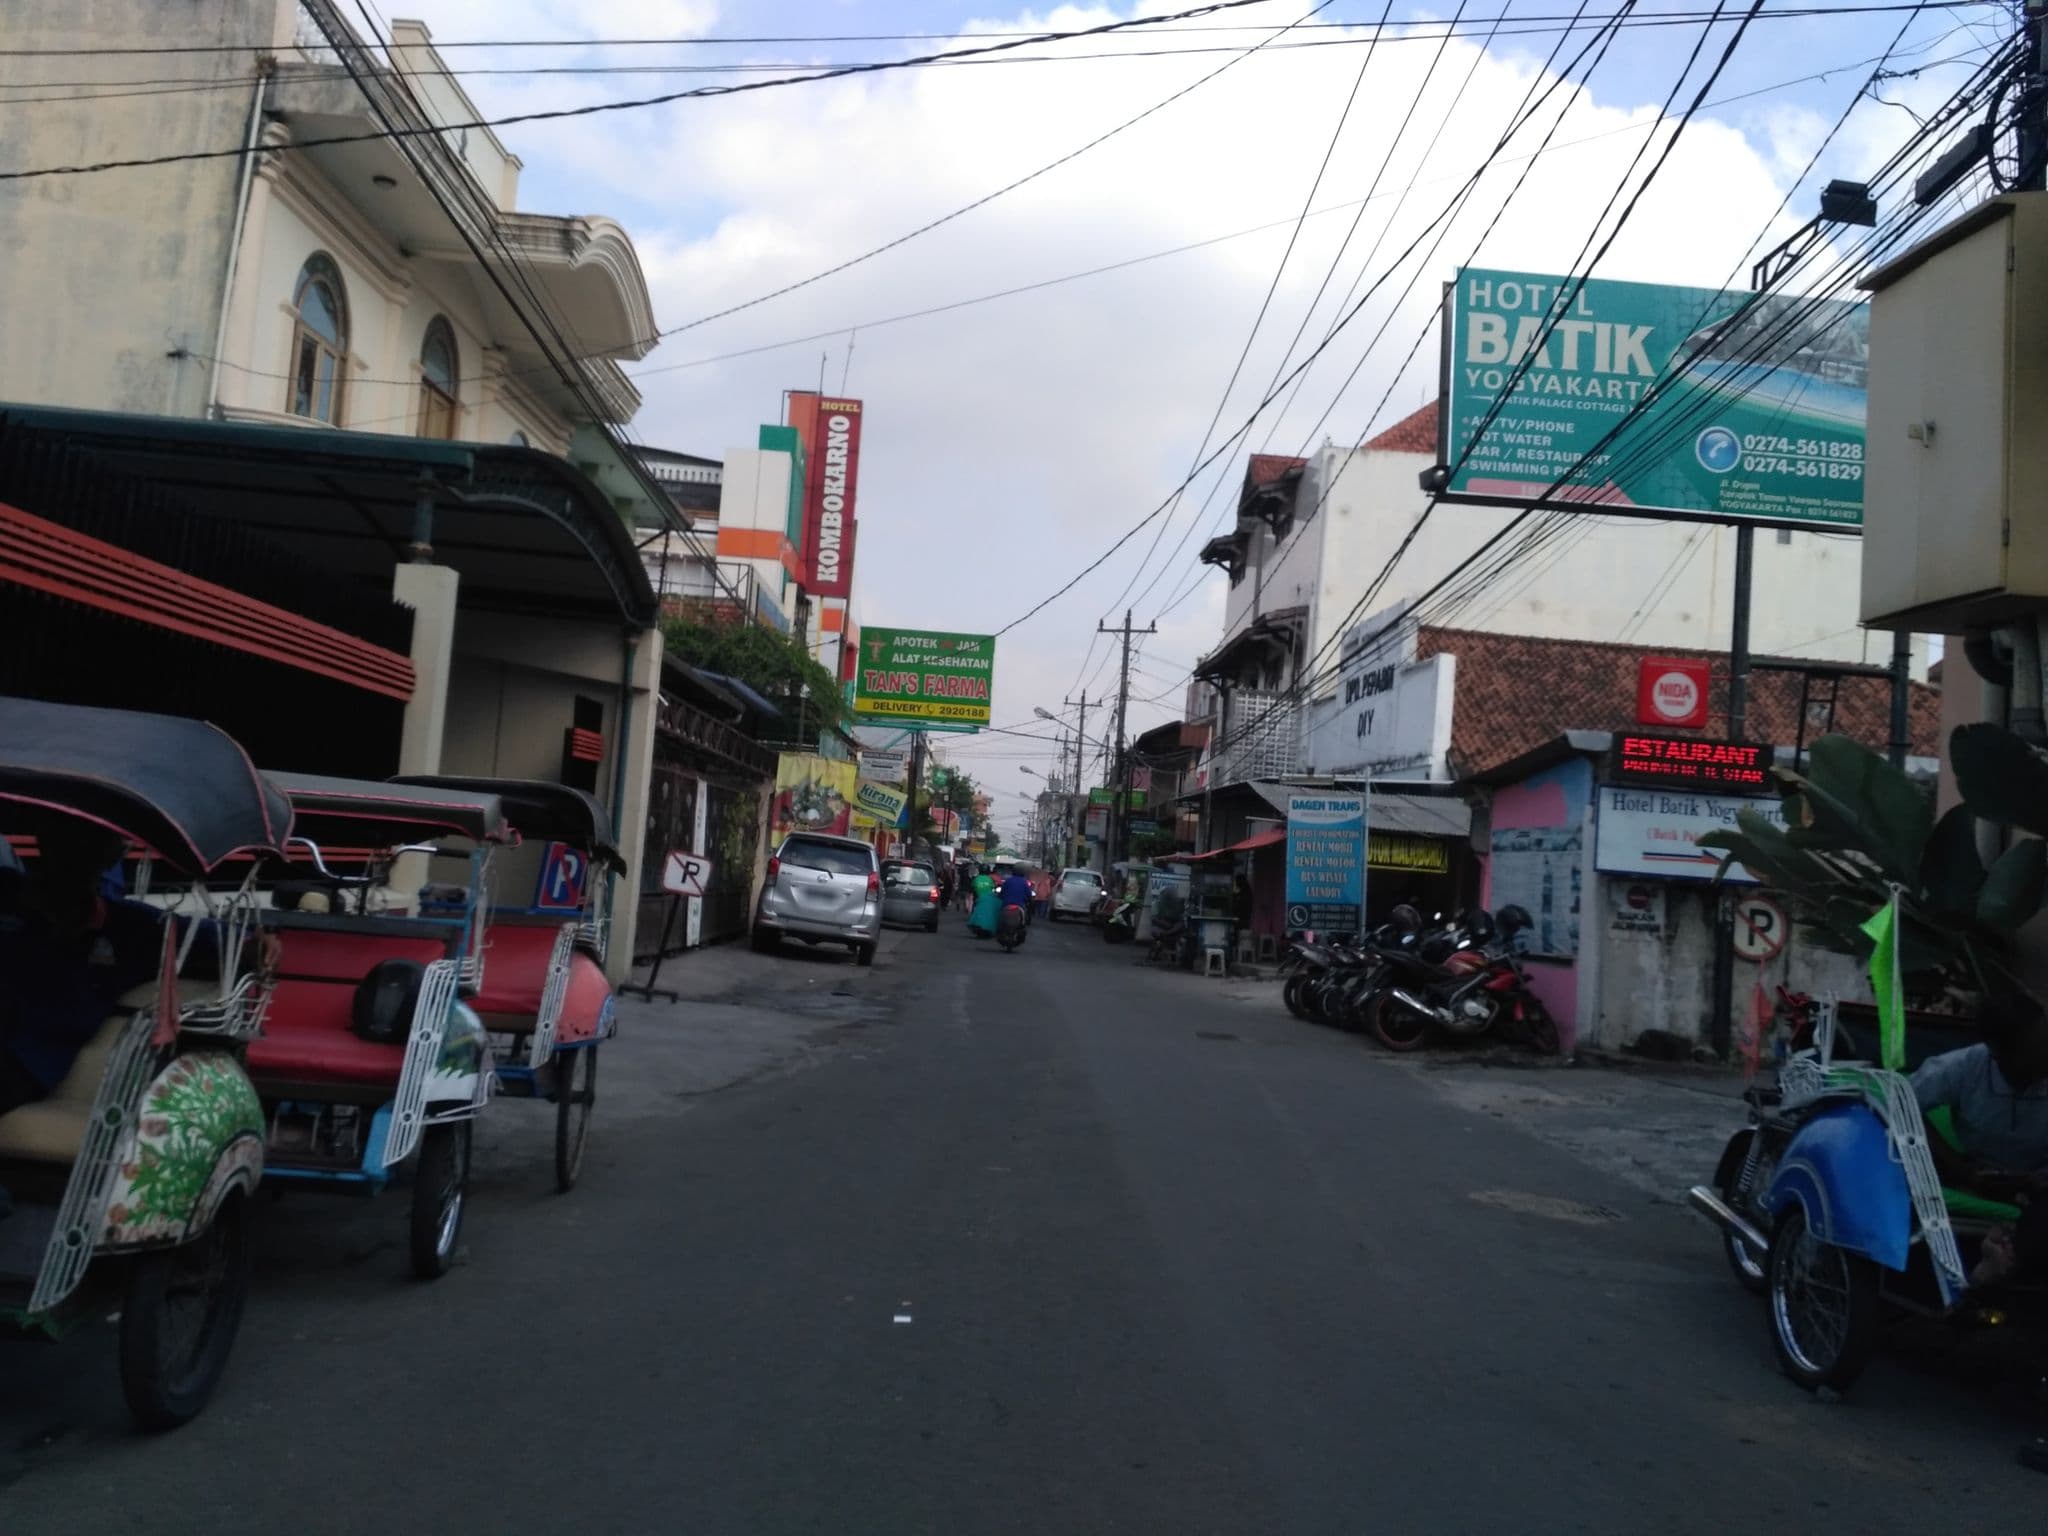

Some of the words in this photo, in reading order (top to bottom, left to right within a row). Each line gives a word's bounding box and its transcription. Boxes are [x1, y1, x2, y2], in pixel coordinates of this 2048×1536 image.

[1469, 279, 1594, 316] HOTEL
[1466, 312, 1657, 378] BATIK
[1465, 368, 1658, 401] YOGYAKARTA
[821, 401, 860, 413] HOTEL
[1532, 397, 1574, 409] PALACE
[1576, 401, 1625, 413] COTTAGE
[1503, 432, 1552, 446] WATER
[1743, 434, 1863, 460] 0274-561828
[1469, 460, 1549, 476] SWIMMING
[1743, 455, 1862, 481] 0274-561829
[816, 415, 850, 582] KOMBOKARNO
[893, 636, 937, 649] APOTEK
[892, 653, 921, 664] ALAT
[923, 655, 989, 669] KESEHATAN
[864, 669, 918, 695] TAN'S
[923, 673, 989, 699] FARMA
[872, 700, 922, 713] DELIVERY
[1622, 737, 1760, 766] ESTAURANT
[1292, 799, 1326, 811] DAGEN
[1327, 800, 1361, 812] TRANS
[1612, 792, 1655, 813] Hotel
[1659, 796, 1700, 818] Batik
[1296, 840, 1325, 853] RENTAL
[681, 860, 700, 884] P
[1294, 855, 1324, 867] RENTAL
[1747, 908, 1773, 946] P
